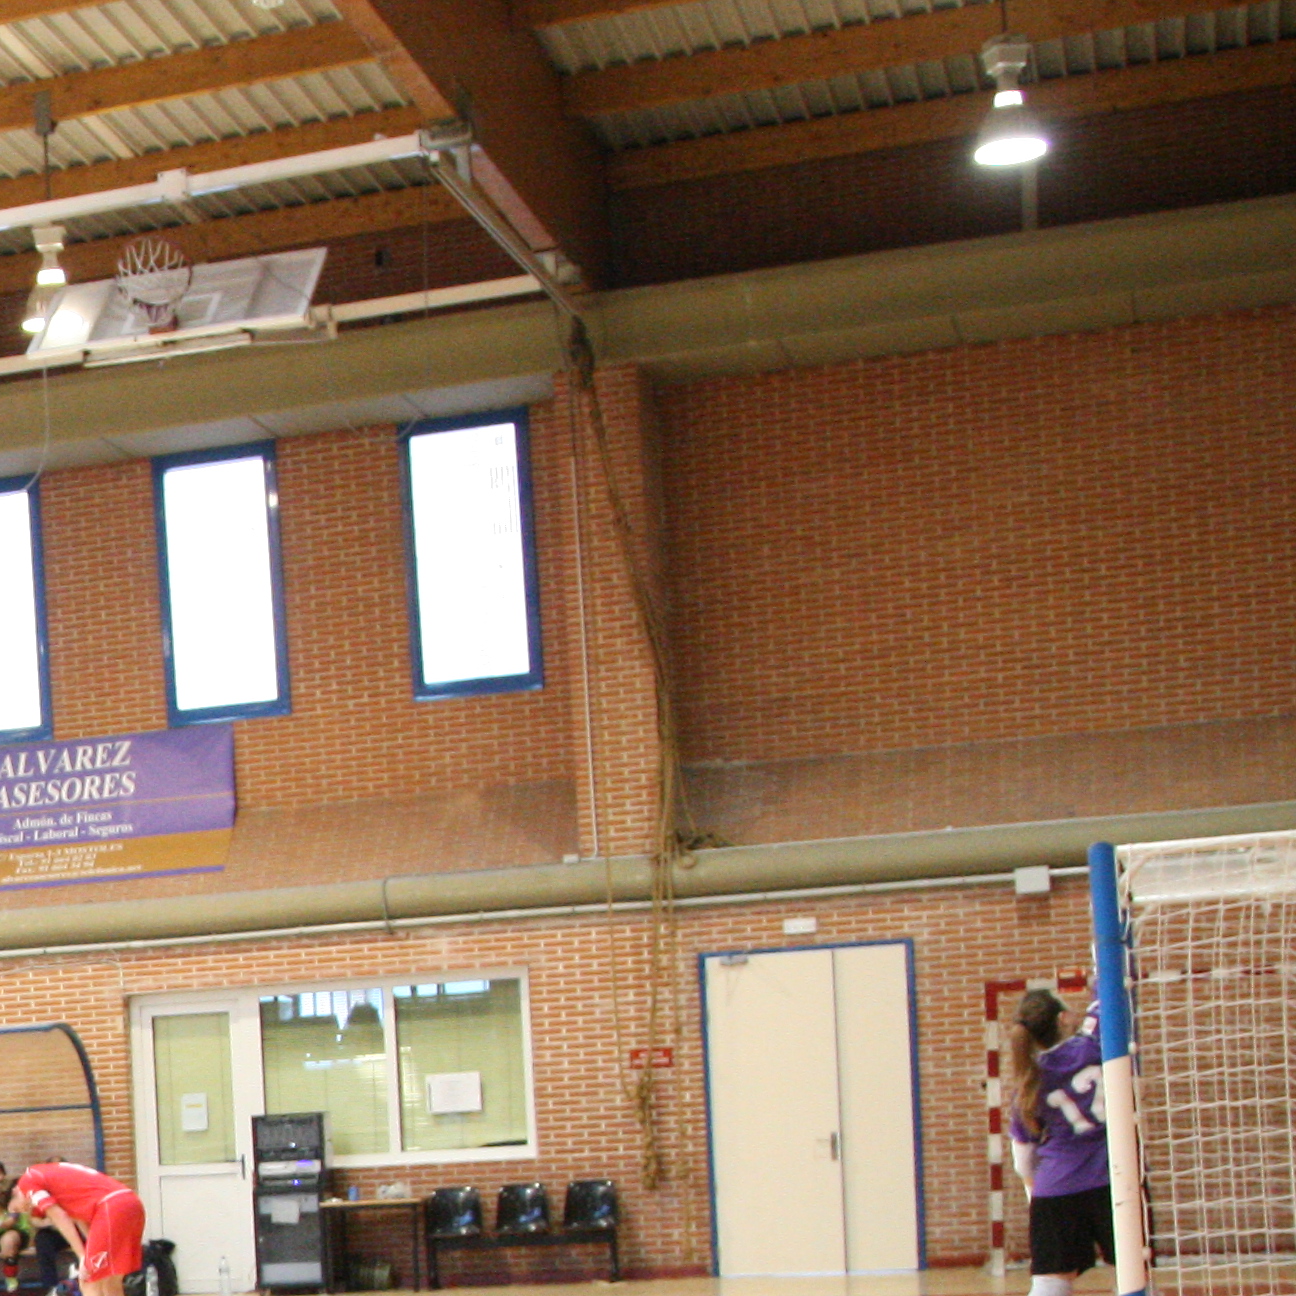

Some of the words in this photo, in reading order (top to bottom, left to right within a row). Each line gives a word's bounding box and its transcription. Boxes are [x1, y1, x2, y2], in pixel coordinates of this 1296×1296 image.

[59, 813, 73, 826] de
[76, 811, 112, 824] Fincas
[34, 826, 79, 841] Laboral
[89, 823, 134, 838] Seguros
